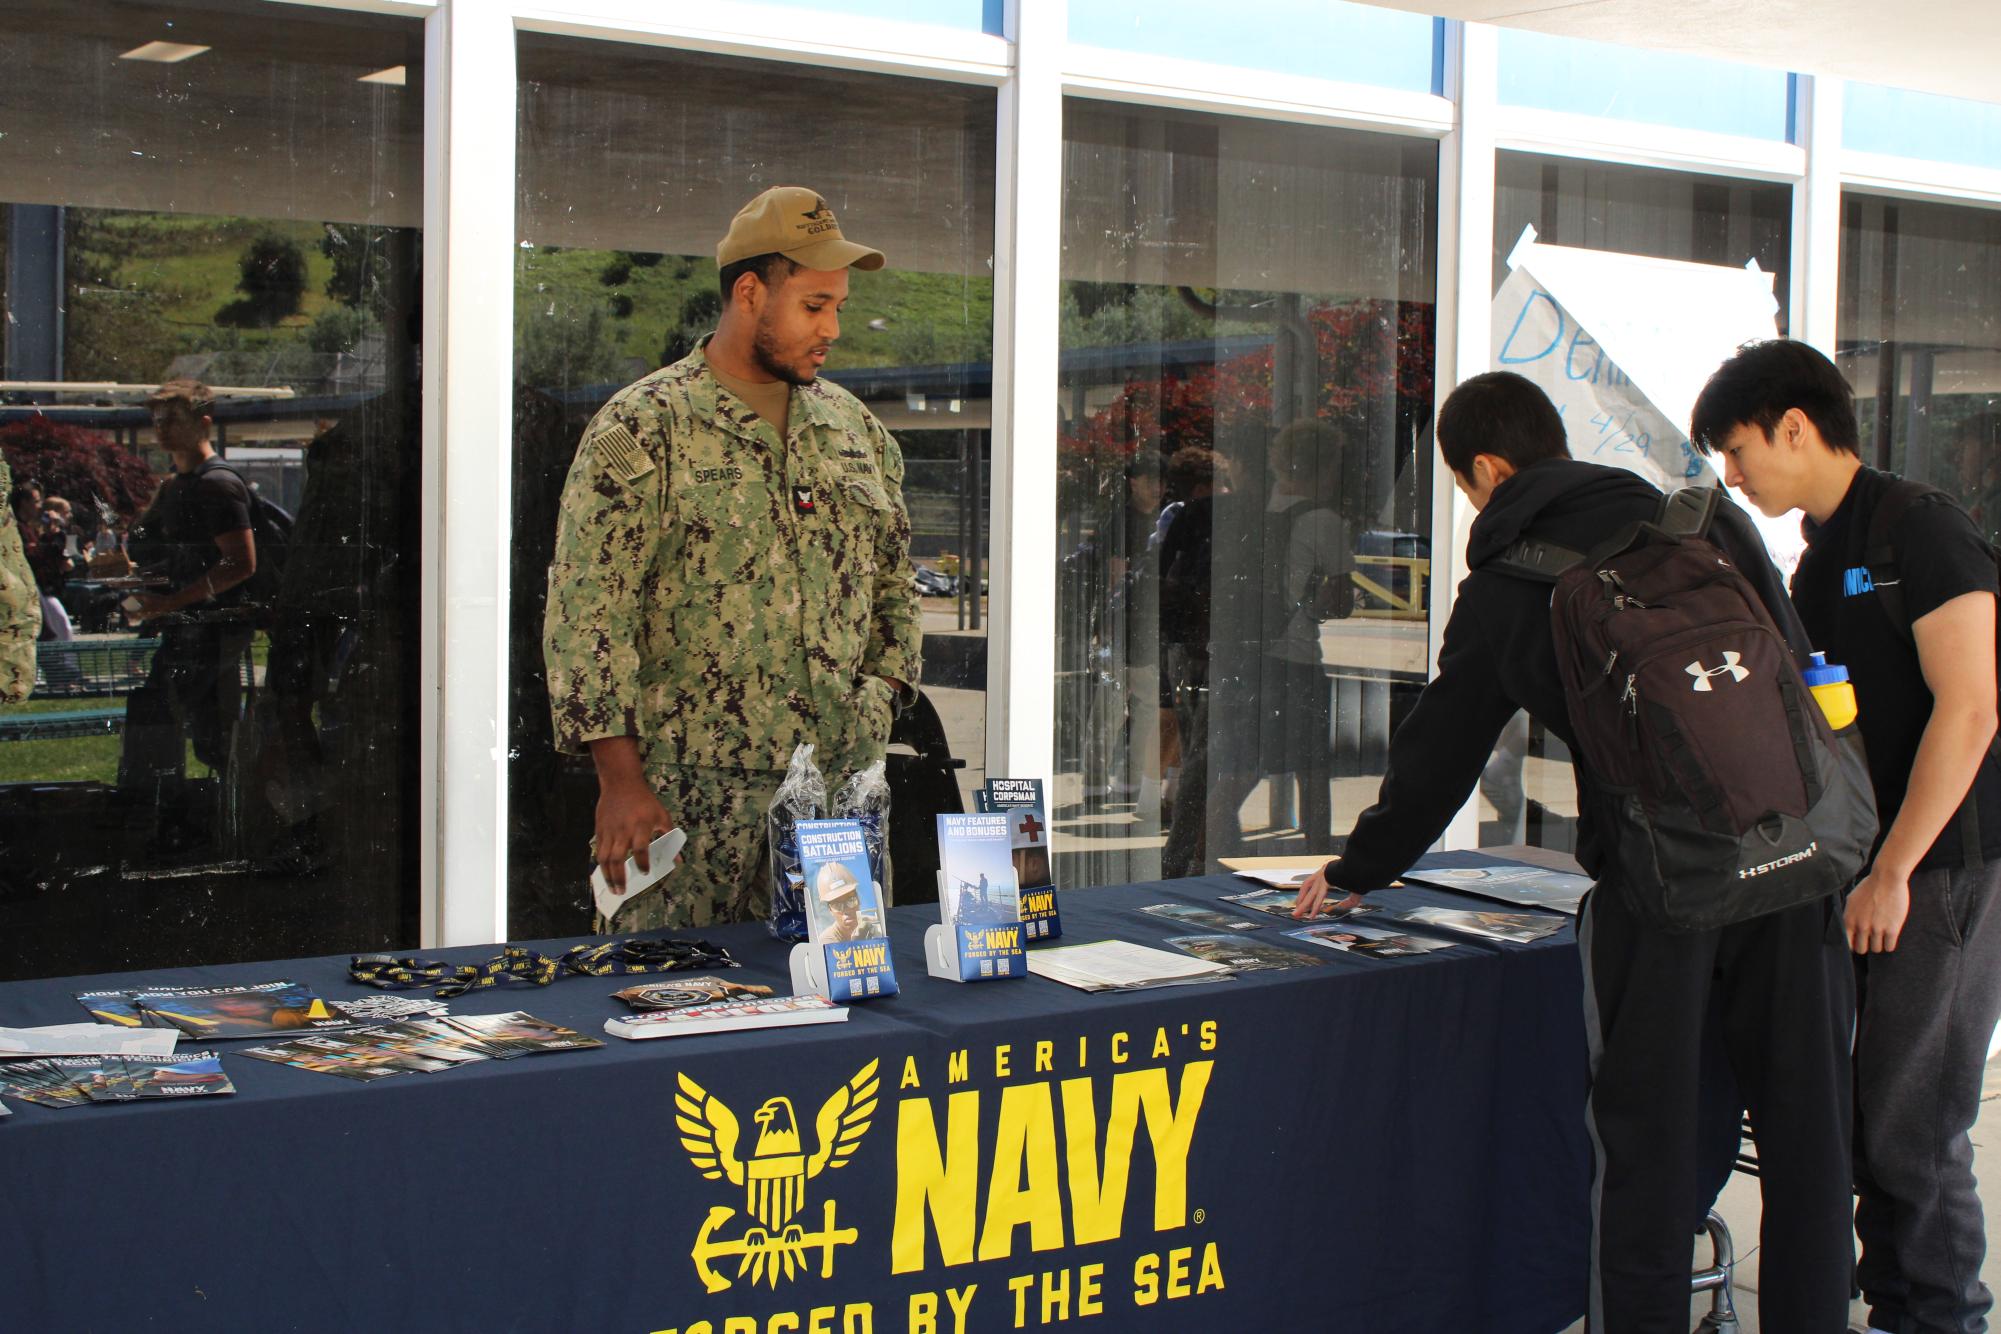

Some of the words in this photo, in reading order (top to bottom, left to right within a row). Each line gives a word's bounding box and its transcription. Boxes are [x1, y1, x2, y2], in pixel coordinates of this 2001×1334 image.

[1590, 411, 1651, 458] 4/29
[695, 467, 743, 484] SPEARS
[992, 780, 1036, 791] HOSPITAL
[993, 791, 1036, 801] CORPSMAN
[946, 816, 966, 826] NAVY
[967, 816, 1007, 826] FEATURES
[800, 830, 862, 845] CONSTRUCTION
[947, 826, 965, 836] AND
[966, 826, 1007, 836] BONUSES
[802, 841, 864, 858] BATTALIONS
[1028, 893, 1053, 913] NAVY
[986, 930, 1019, 950] NAVY
[853, 947, 886, 968] NAVY
[867, 966, 878, 974] THE
[174, 989, 211, 997] YOU
[211, 986, 247, 994] CAN
[250, 981, 288, 991] JOIN
[900, 1020, 1217, 1089] AMERICA'S
[891, 1059, 1215, 1275] NAVY
[908, 1284, 978, 1334] BY
[1008, 1263, 1104, 1329] THE
[1133, 1242, 1226, 1306] SEA
